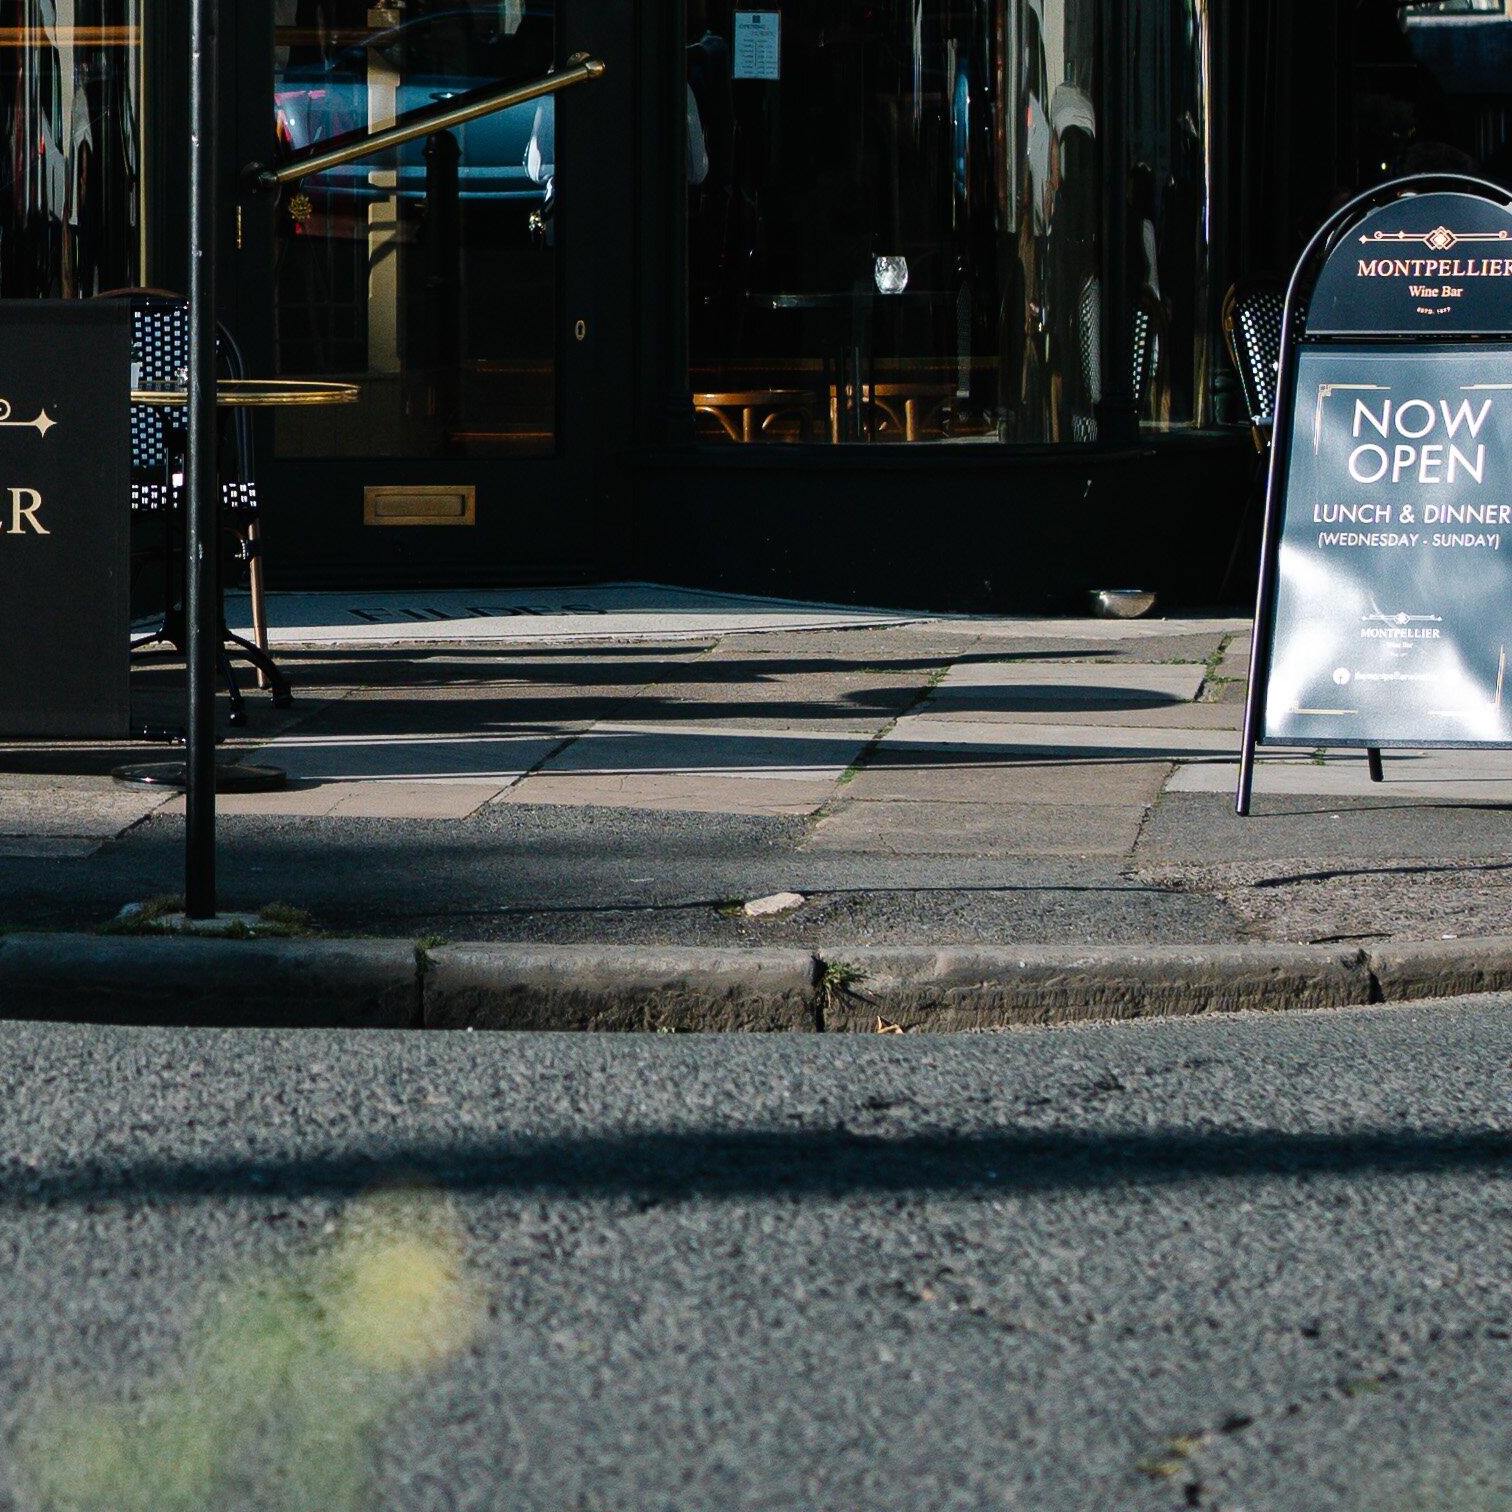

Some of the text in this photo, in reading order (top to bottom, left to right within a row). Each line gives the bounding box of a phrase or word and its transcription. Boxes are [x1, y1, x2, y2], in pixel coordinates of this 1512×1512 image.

[1357, 259, 1512, 277] MONTPELLIER
[1408, 285, 1464, 297] Wine Bar
[1352, 398, 1492, 438] NOW
[1348, 443, 1485, 484] OPEN
[1313, 503, 1511, 524] LUNCH & DINNER
[1318, 532, 1419, 548] (WEDNESDAY
[1432, 533, 1500, 550] SUNDAY)
